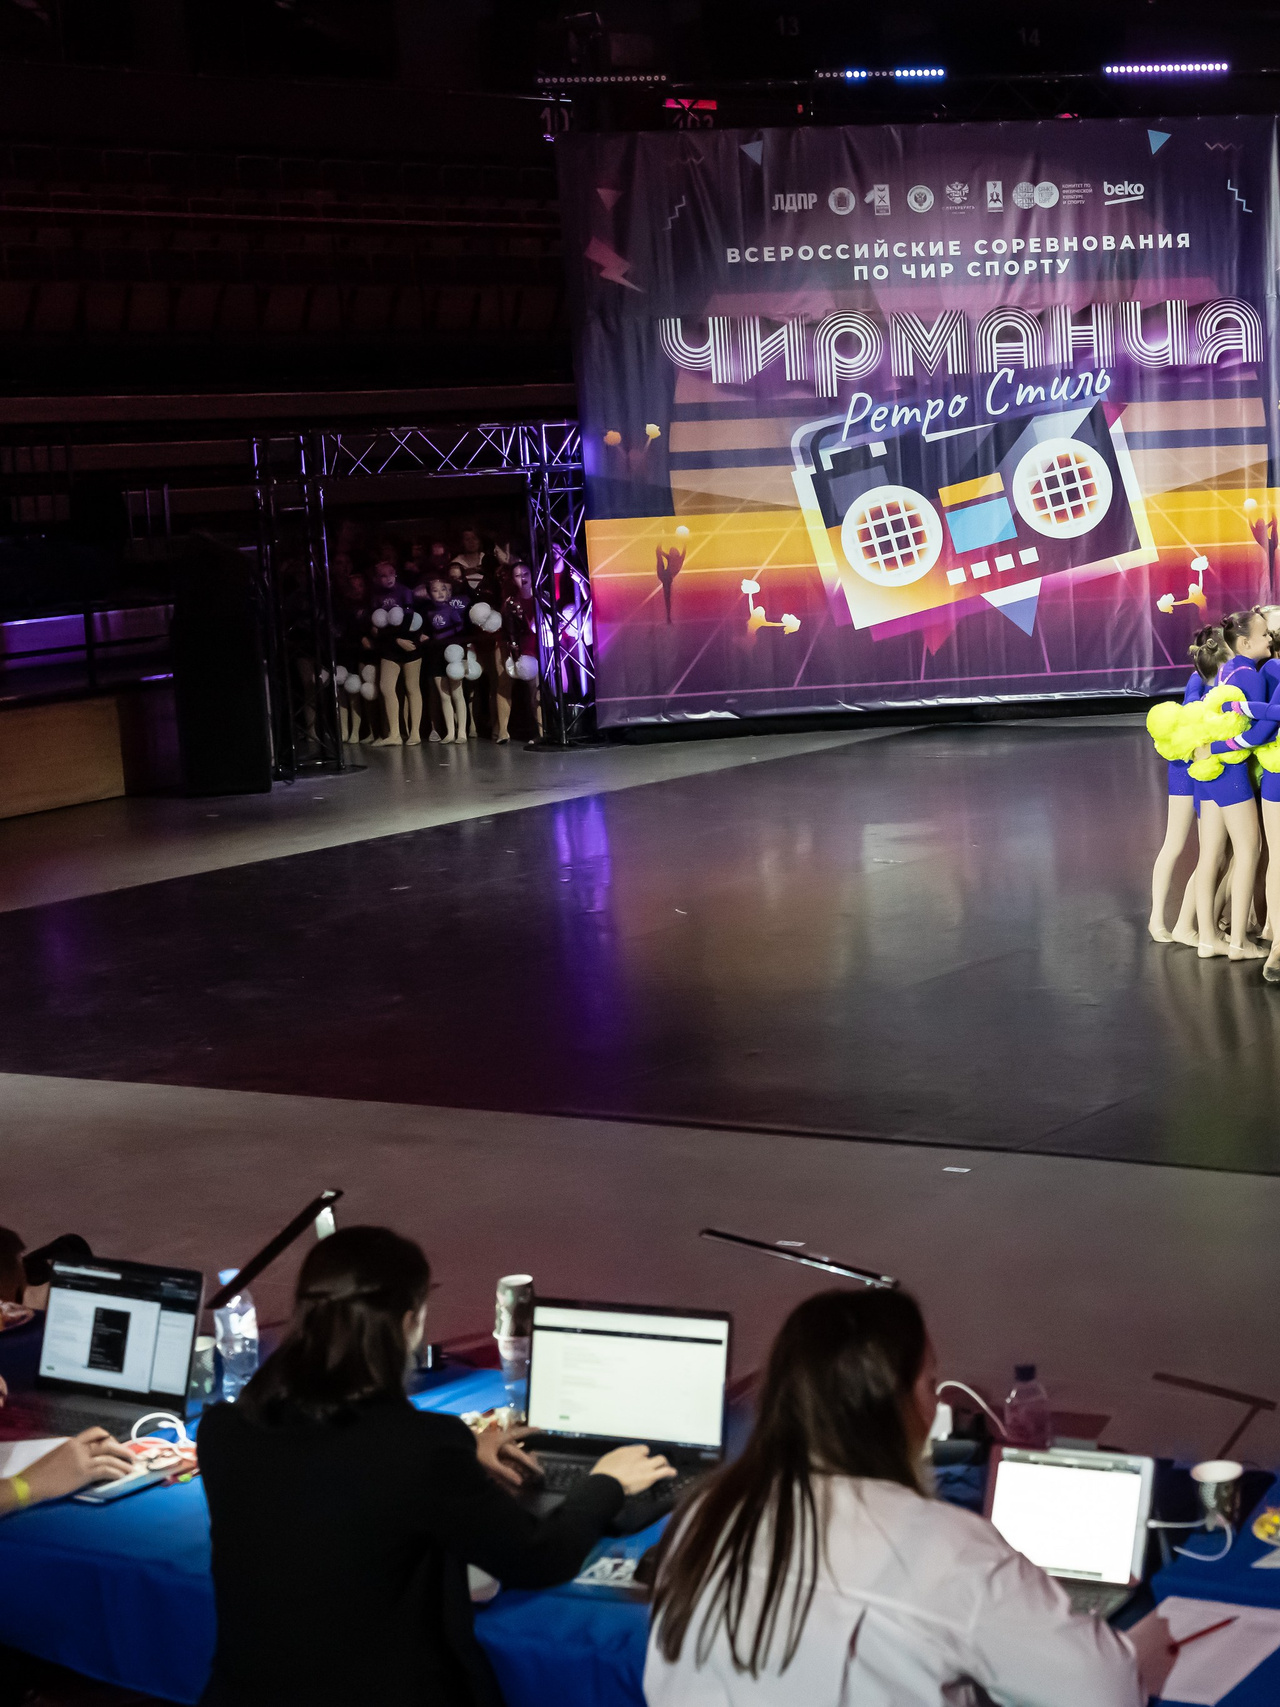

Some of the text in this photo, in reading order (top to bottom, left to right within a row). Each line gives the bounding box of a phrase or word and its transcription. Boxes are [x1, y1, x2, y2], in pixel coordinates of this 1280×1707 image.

[1103, 181, 1145, 196] beko
[772, 193, 818, 213] ЛДПР
[726, 233, 1190, 263] ВСЕРОССИЙСКИЕ СОРЕВНОВАНИЯ
[853, 258, 1070, 281] ПО ЧИР СПОРТУ
[841, 366, 1112, 442] Ретро Стиль
